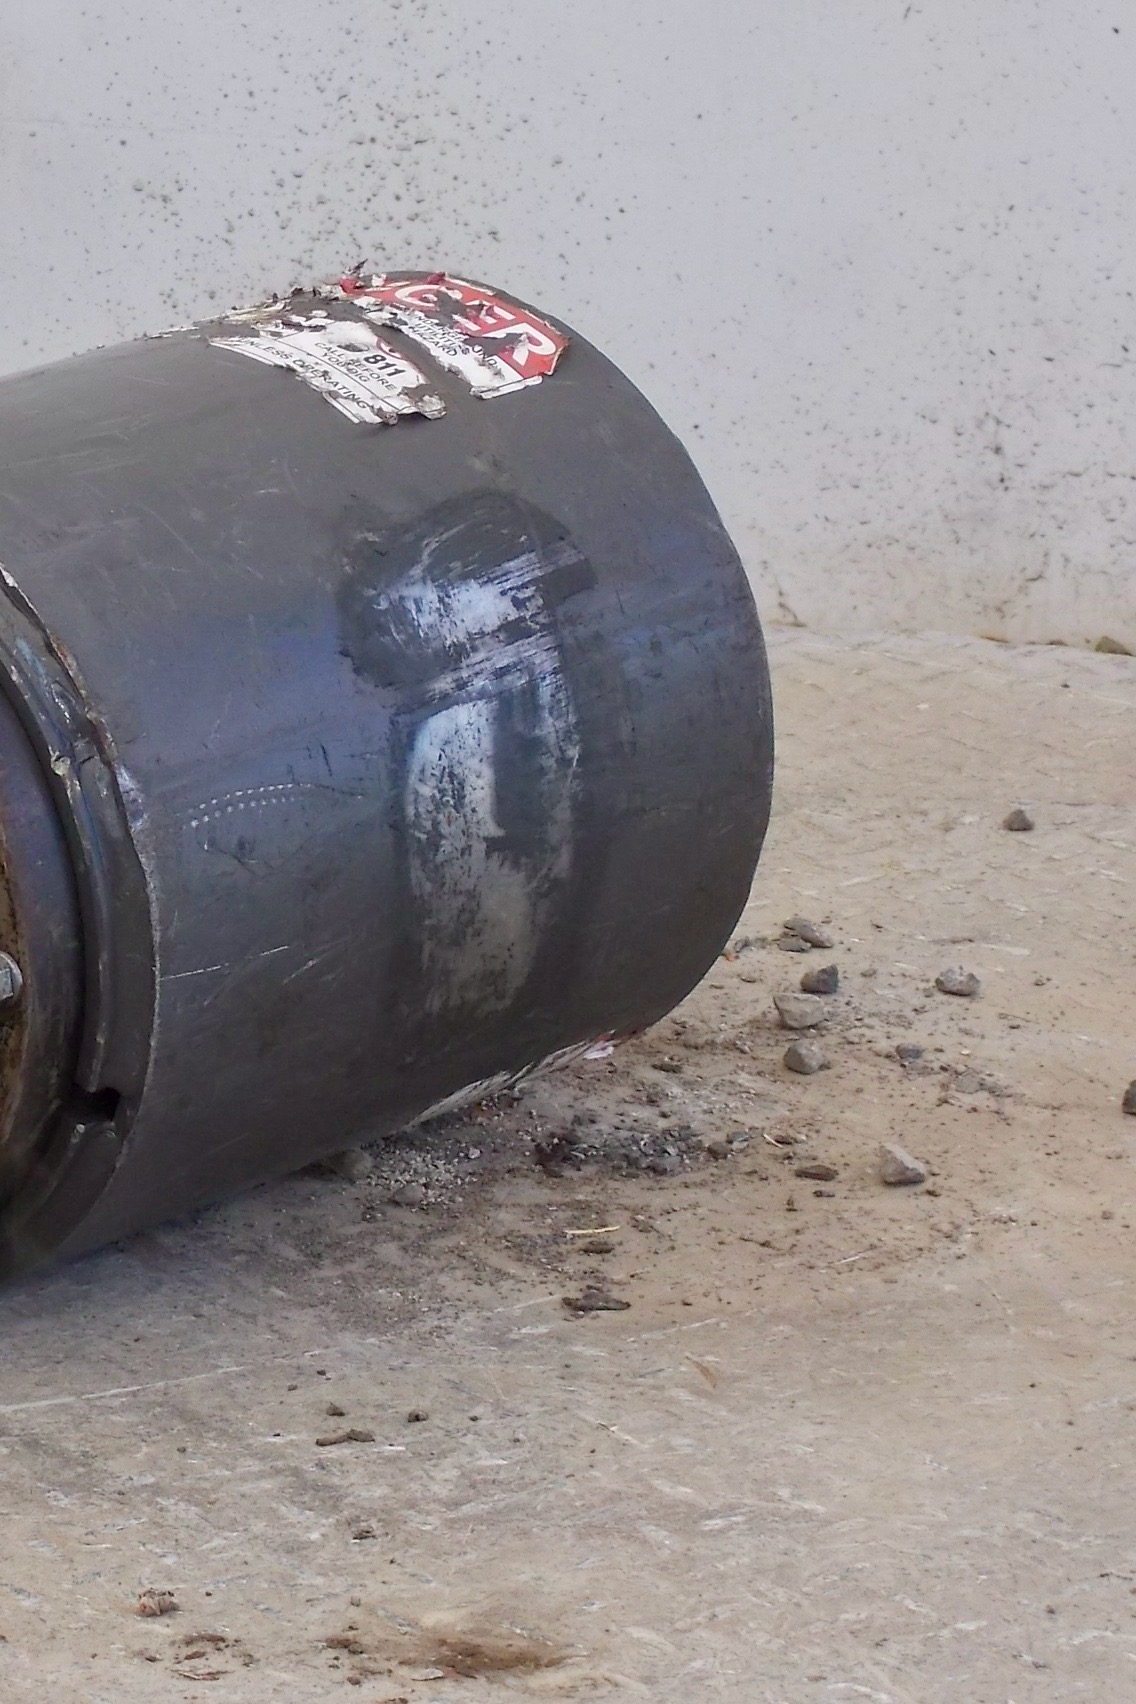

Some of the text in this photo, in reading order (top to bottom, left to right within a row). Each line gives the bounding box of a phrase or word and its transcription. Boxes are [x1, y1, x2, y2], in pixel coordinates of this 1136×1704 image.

[415, 323, 470, 355] UTILITIS
[315, 342, 397, 391] CALL BEFORE
[322, 352, 371, 382] YOU DIG
[363, 354, 406, 376] 811
[292, 358, 368, 409] OPERATING
